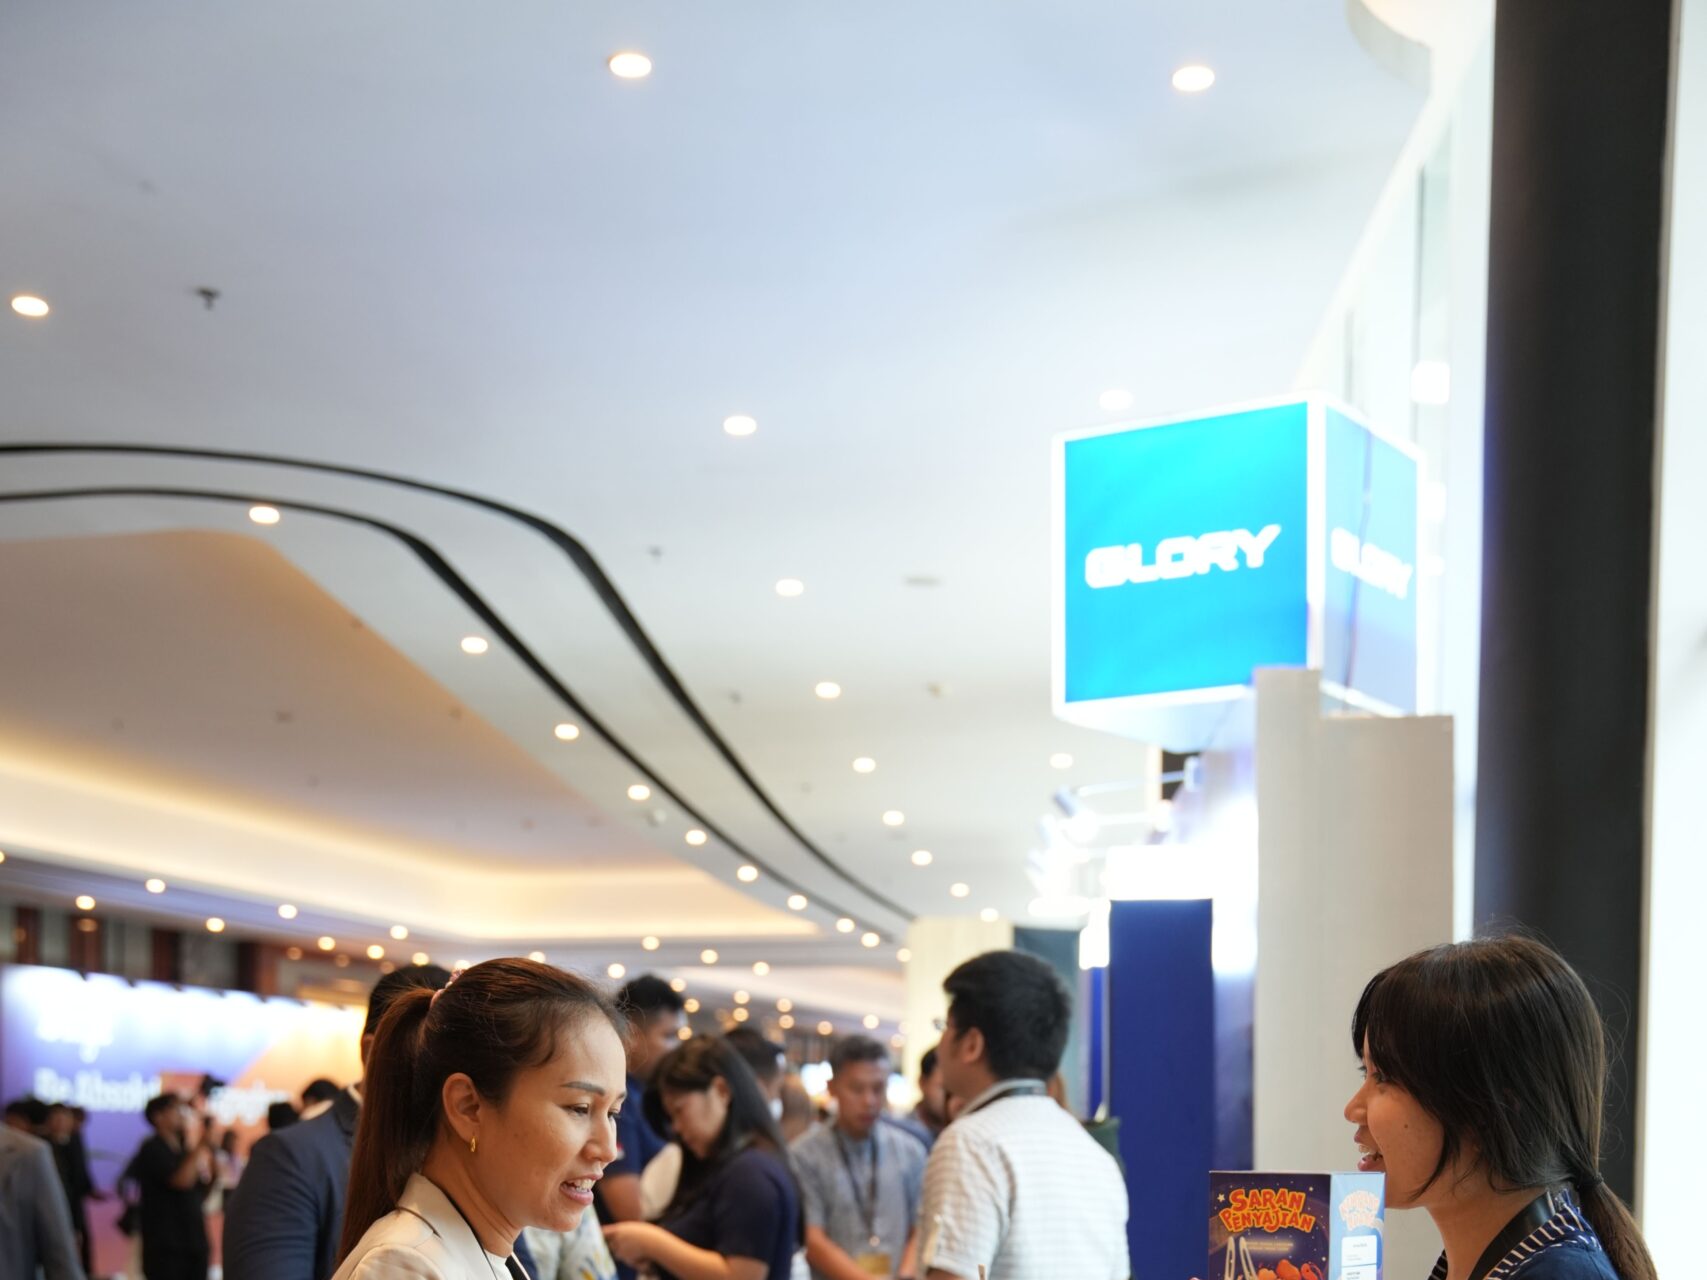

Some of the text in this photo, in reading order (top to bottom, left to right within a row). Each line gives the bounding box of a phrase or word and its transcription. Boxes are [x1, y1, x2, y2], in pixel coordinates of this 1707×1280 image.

[1085, 524, 1282, 589] GLORY
[1229, 1187, 1306, 1212] SARAN
[1219, 1207, 1316, 1233] PENYAJIAN
